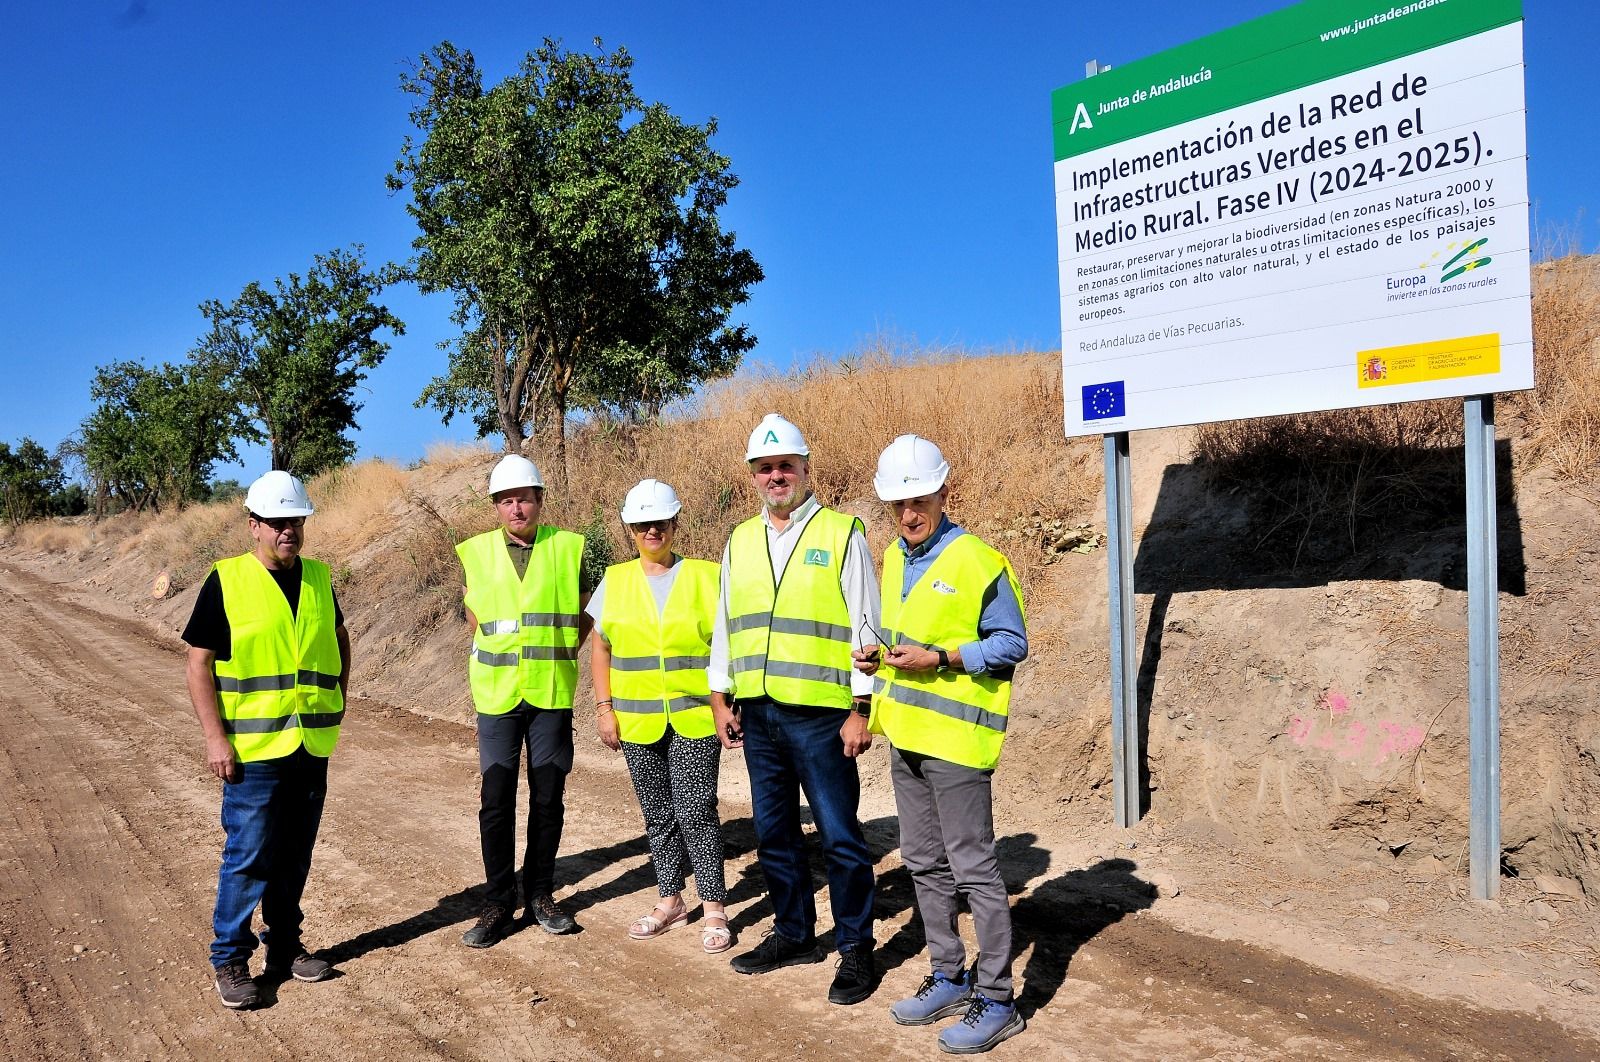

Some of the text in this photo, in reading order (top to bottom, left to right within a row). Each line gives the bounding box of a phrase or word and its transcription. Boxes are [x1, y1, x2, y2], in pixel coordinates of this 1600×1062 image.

[1097, 67, 1212, 116] Junta de Andalucía
[1073, 73, 1427, 191] Implementación de la Red de
[1074, 108, 1423, 222] Infraestructuras Verdes en el
[1076, 131, 1493, 252] Medio Rural. Fase IV (2024-2025).
[1077, 177, 1493, 277] Restaurar, preservar y mejorar la biodiversidad (en zonas Natura 2000 y
[1078, 197, 1494, 292] en zonas con limitaciones naturales u otras limitaciones específicas), los
[1078, 216, 1496, 306] sistemas agrarios con alto valor natural, y el estado de los paisajes
[1079, 306, 1126, 321] europeos.
[1387, 275, 1425, 290] Europa
[1387, 277, 1497, 302] invierte en las zonas rurales
[1080, 315, 1245, 352] Red Andaluza de Vías Pecuarias.
[156, 582, 165, 590] 20
